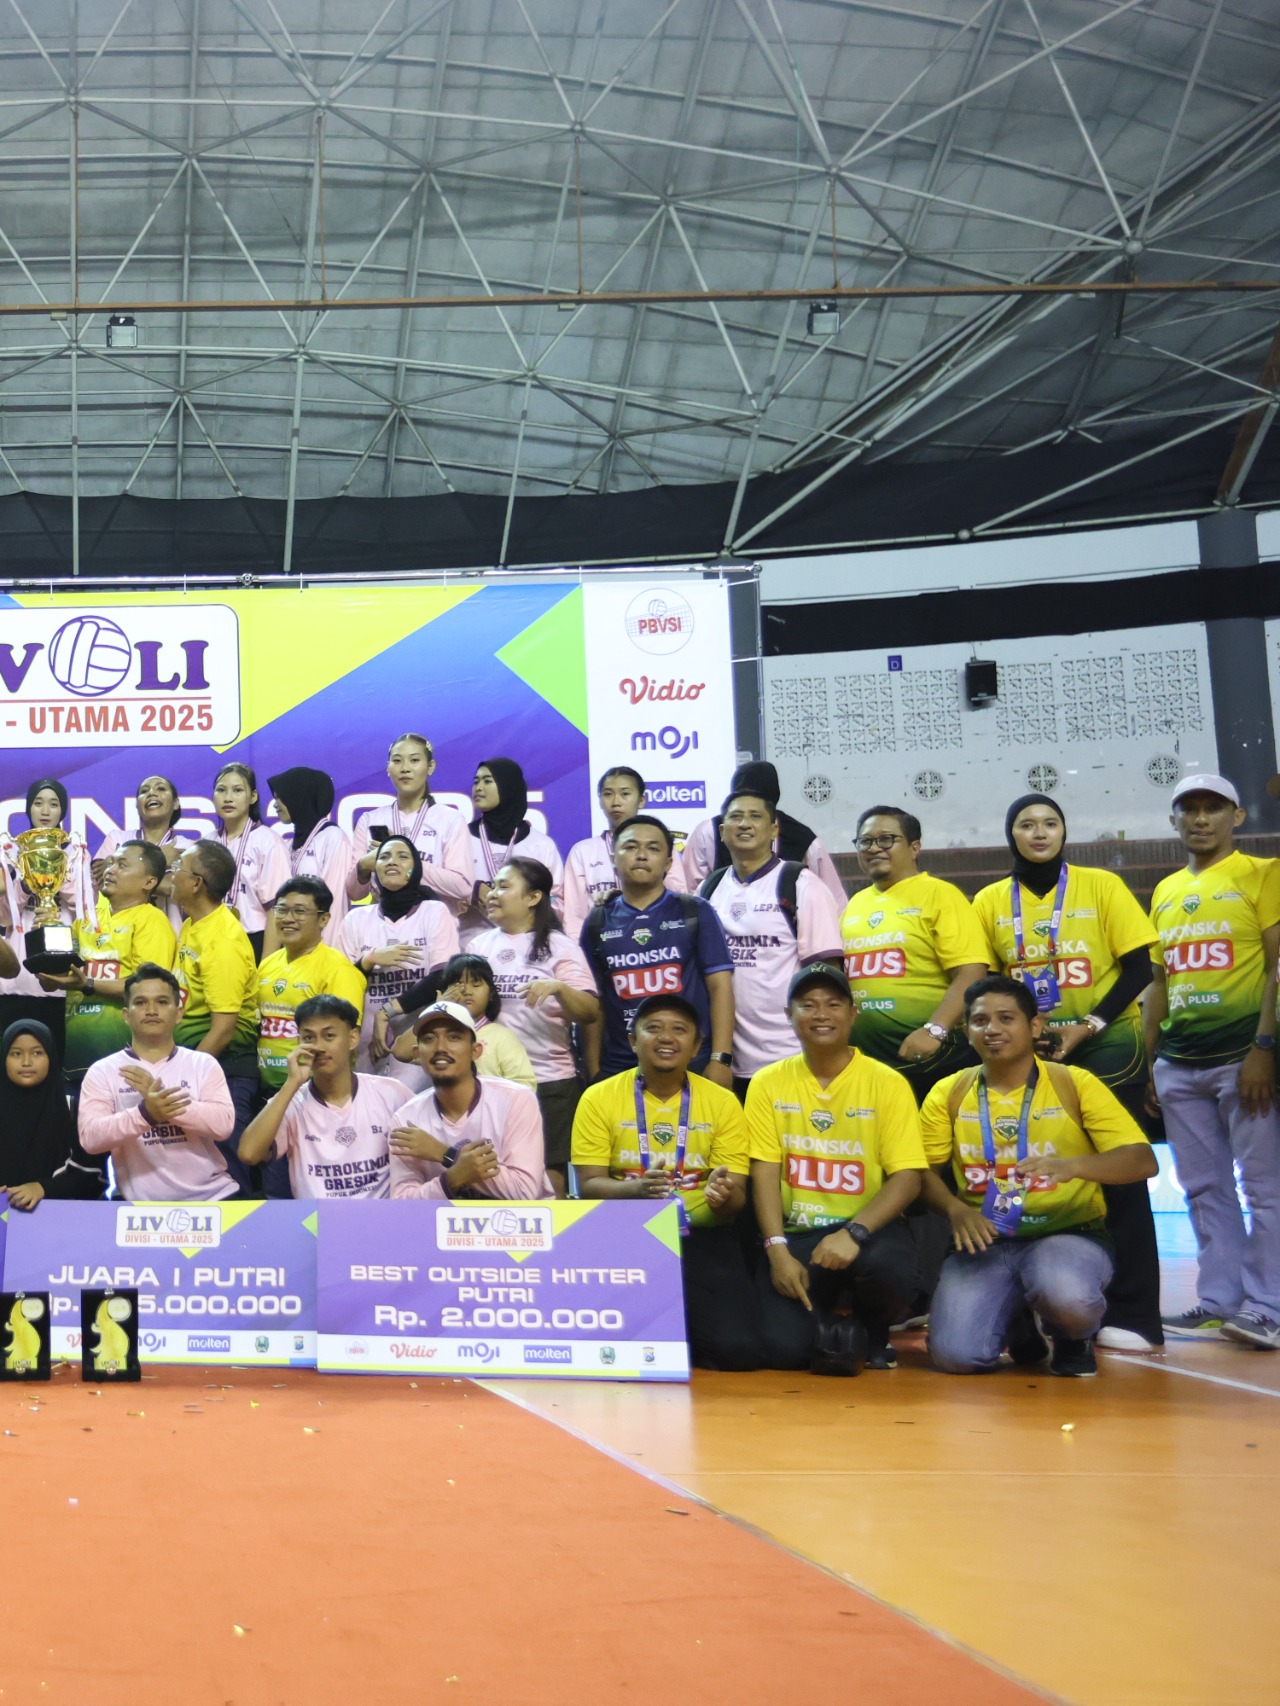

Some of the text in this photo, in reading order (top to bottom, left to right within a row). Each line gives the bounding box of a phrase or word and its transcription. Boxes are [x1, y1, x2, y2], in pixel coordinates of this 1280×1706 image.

[638, 617, 681, 634] PBVSI
[891, 661, 899, 670] D
[619, 676, 705, 704] Vidio
[28, 706, 130, 734] UTAMA
[140, 704, 214, 732] 2025
[727, 935, 781, 947] OKIMIA
[843, 931, 905, 949] HONSKA
[607, 946, 680, 968] PHONSKA
[733, 949, 757, 961] SIK
[1164, 942, 1229, 974] PLUS
[86, 963, 116, 981] LUS
[370, 968, 426, 983] TROKIMI
[491, 974, 539, 983] OKIMIA
[495, 983, 517, 993] SIK
[612, 967, 679, 996] PLUS
[862, 1001, 893, 1010] PLUS
[1188, 994, 1220, 1004] PLUS
[79, 1004, 101, 1013] PLUS
[624, 1009, 637, 1017] PET
[261, 1019, 300, 1037] LUS
[267, 1058, 288, 1067] PLUS
[960, 1141, 1056, 1159] PHONKA
[792, 1201, 824, 1213] ETRO
[125, 1234, 212, 1244] DIVISI UTAMA 2025
[447, 1237, 544, 1247] DIVISI UTAMA 2025
[48, 1265, 159, 1286] JUARA
[194, 1267, 285, 1286] PUTRI
[350, 1264, 646, 1284] BEST OUTSIDE HITTER
[458, 1286, 534, 1303] PUTRI
[50, 1296, 79, 1315] p.
[375, 1305, 624, 1331] Rp. 2.000.000
[188, 1337, 229, 1349] molten
[390, 1343, 437, 1359] Vidio
[525, 1348, 570, 1359] molten
